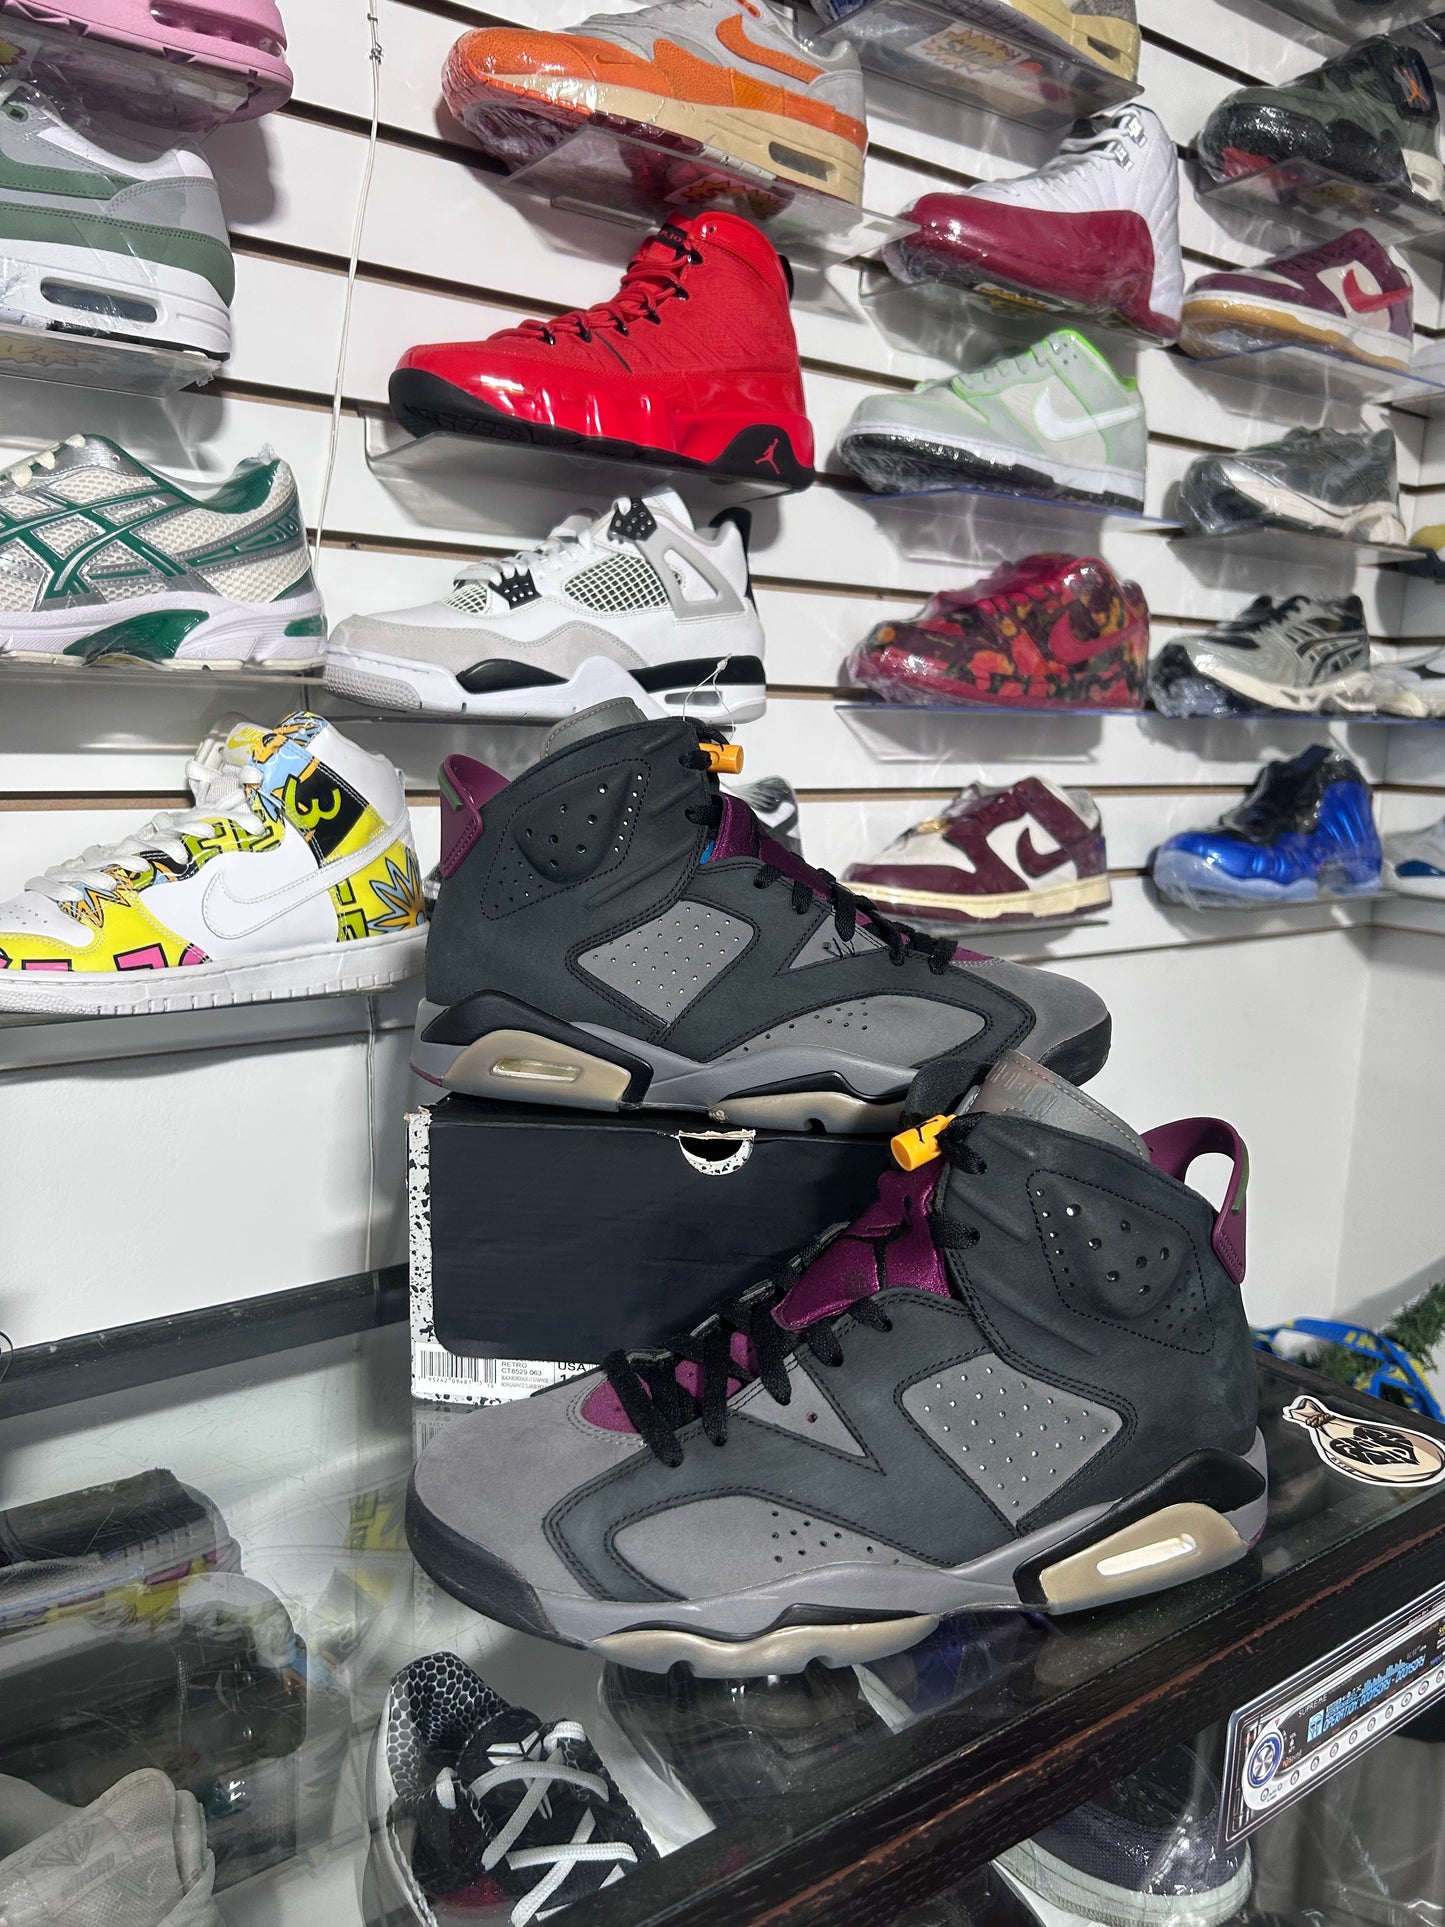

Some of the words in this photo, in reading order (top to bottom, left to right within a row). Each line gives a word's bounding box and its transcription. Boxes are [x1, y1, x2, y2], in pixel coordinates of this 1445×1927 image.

[501, 1361, 527, 1369] RETRO
[558, 1361, 587, 1372] USA
[501, 1367, 528, 1375] CT8529
[1298, 1694, 1328, 1718] SUPREME
